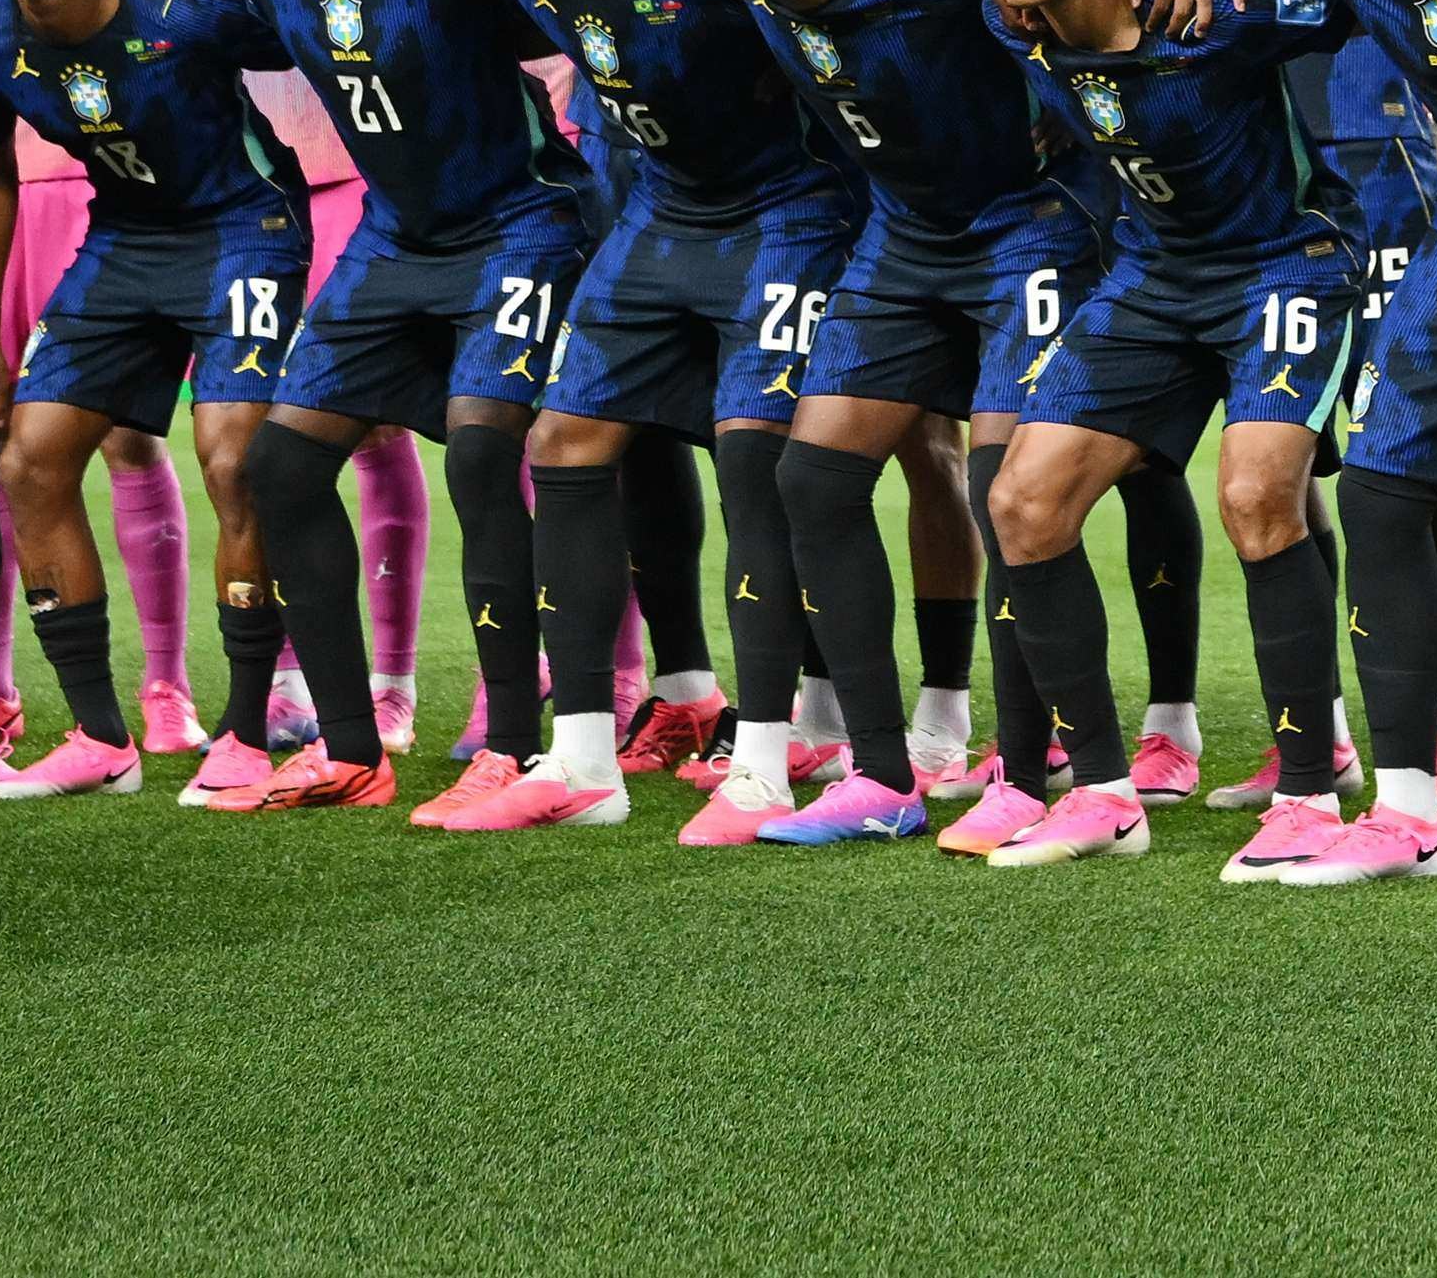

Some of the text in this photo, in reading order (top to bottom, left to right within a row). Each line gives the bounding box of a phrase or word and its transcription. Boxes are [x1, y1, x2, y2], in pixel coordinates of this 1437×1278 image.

[331, 49, 372, 63] BRASIL
[592, 74, 633, 89] BRASIL
[79, 121, 124, 134] BRASIL
[336, 73, 403, 133] 21
[837, 101, 881, 148] 6
[1110, 154, 1174, 203] 16
[227, 277, 278, 340] 18
[494, 276, 552, 344] 21
[1025, 268, 1060, 337] 6
[1262, 292, 1317, 355] 16
